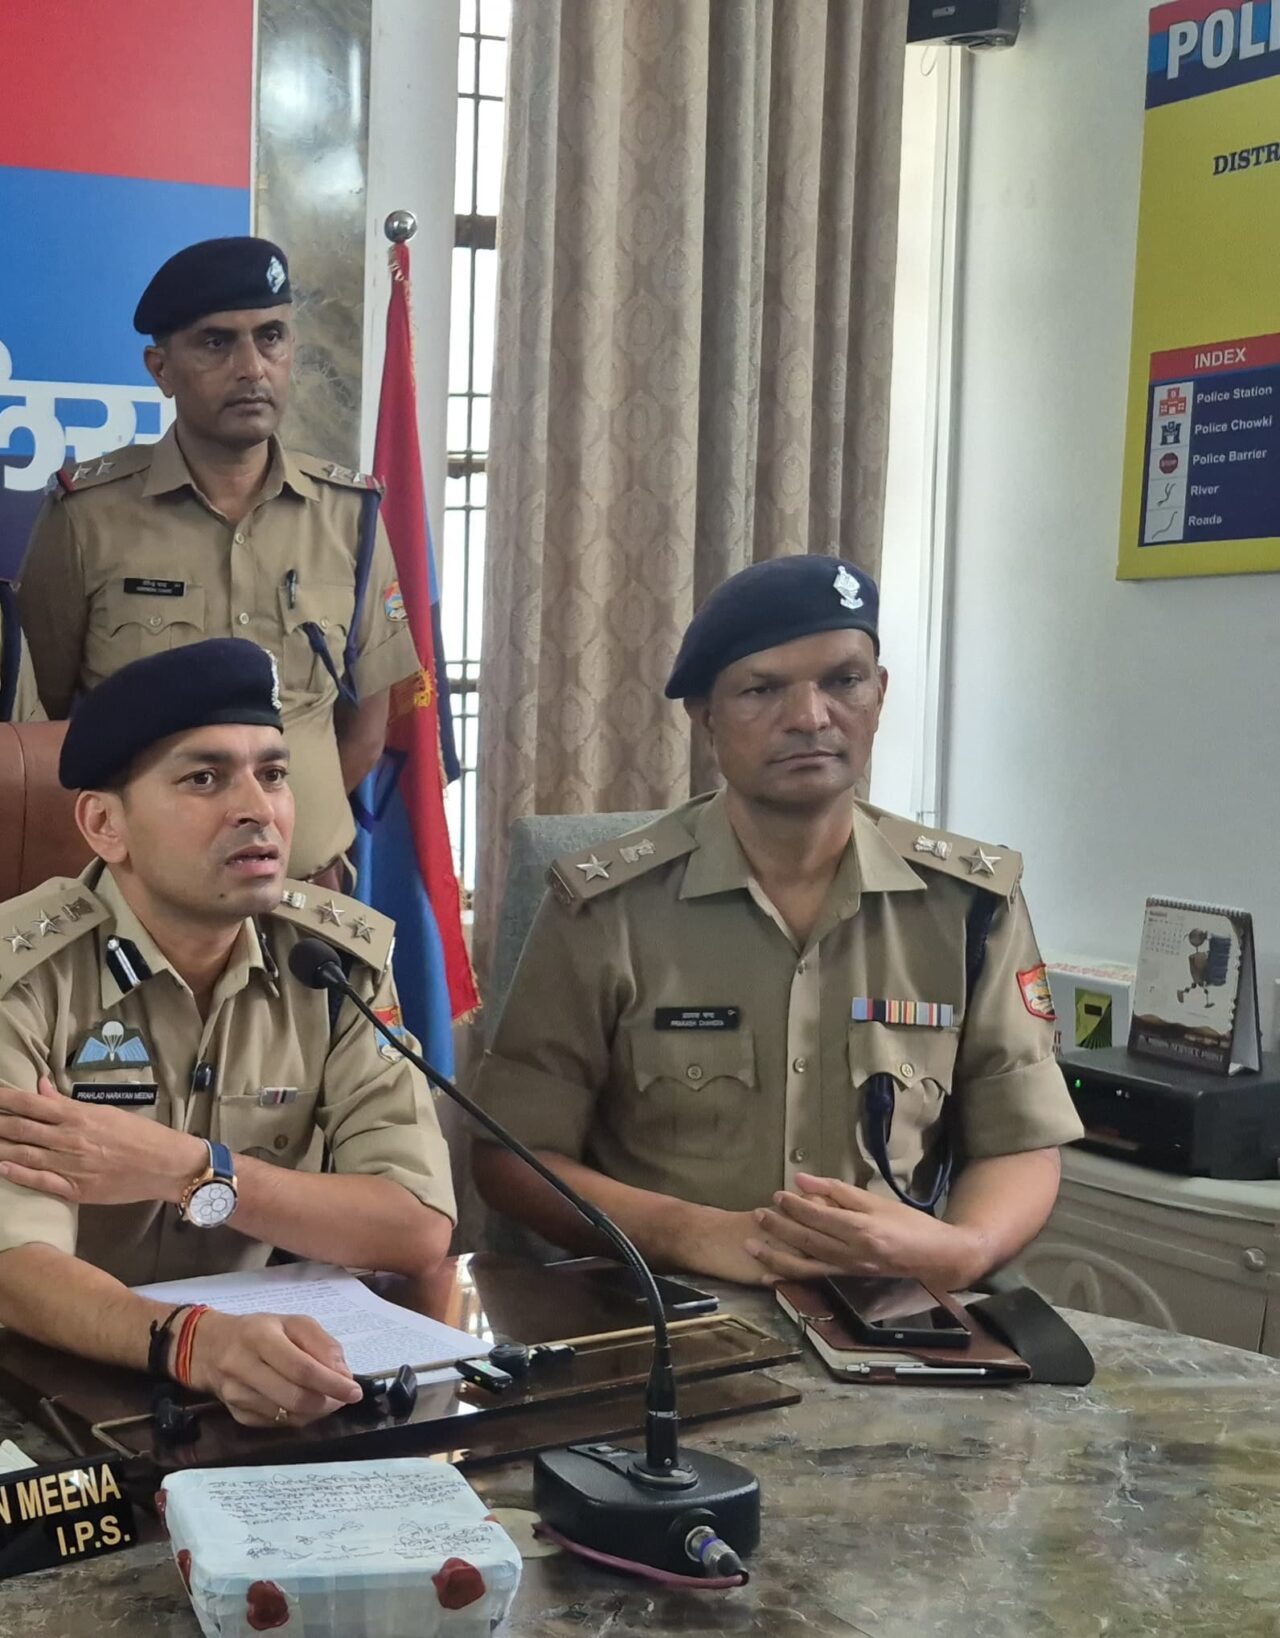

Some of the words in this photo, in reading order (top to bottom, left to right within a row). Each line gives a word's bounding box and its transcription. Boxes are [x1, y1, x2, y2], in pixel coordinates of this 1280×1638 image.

[1167, 0, 1280, 80] POLI
[1194, 347, 1246, 369] INDEX
[1196, 391, 1230, 404] Police
[1233, 386, 1273, 399] Station
[1194, 422, 1228, 435] Police
[1231, 415, 1272, 431] Chowki
[1192, 453, 1226, 466] Police
[1228, 449, 1268, 462] Barrier
[1190, 484, 1220, 497] River
[76, 1091, 105, 1100] PRAHLAD
[105, 1091, 134, 1100] NARAYAN
[134, 1091, 155, 1100] MEENA
[16, 1463, 122, 1521] MEENA
[56, 1515, 131, 1557] I.P.S.
